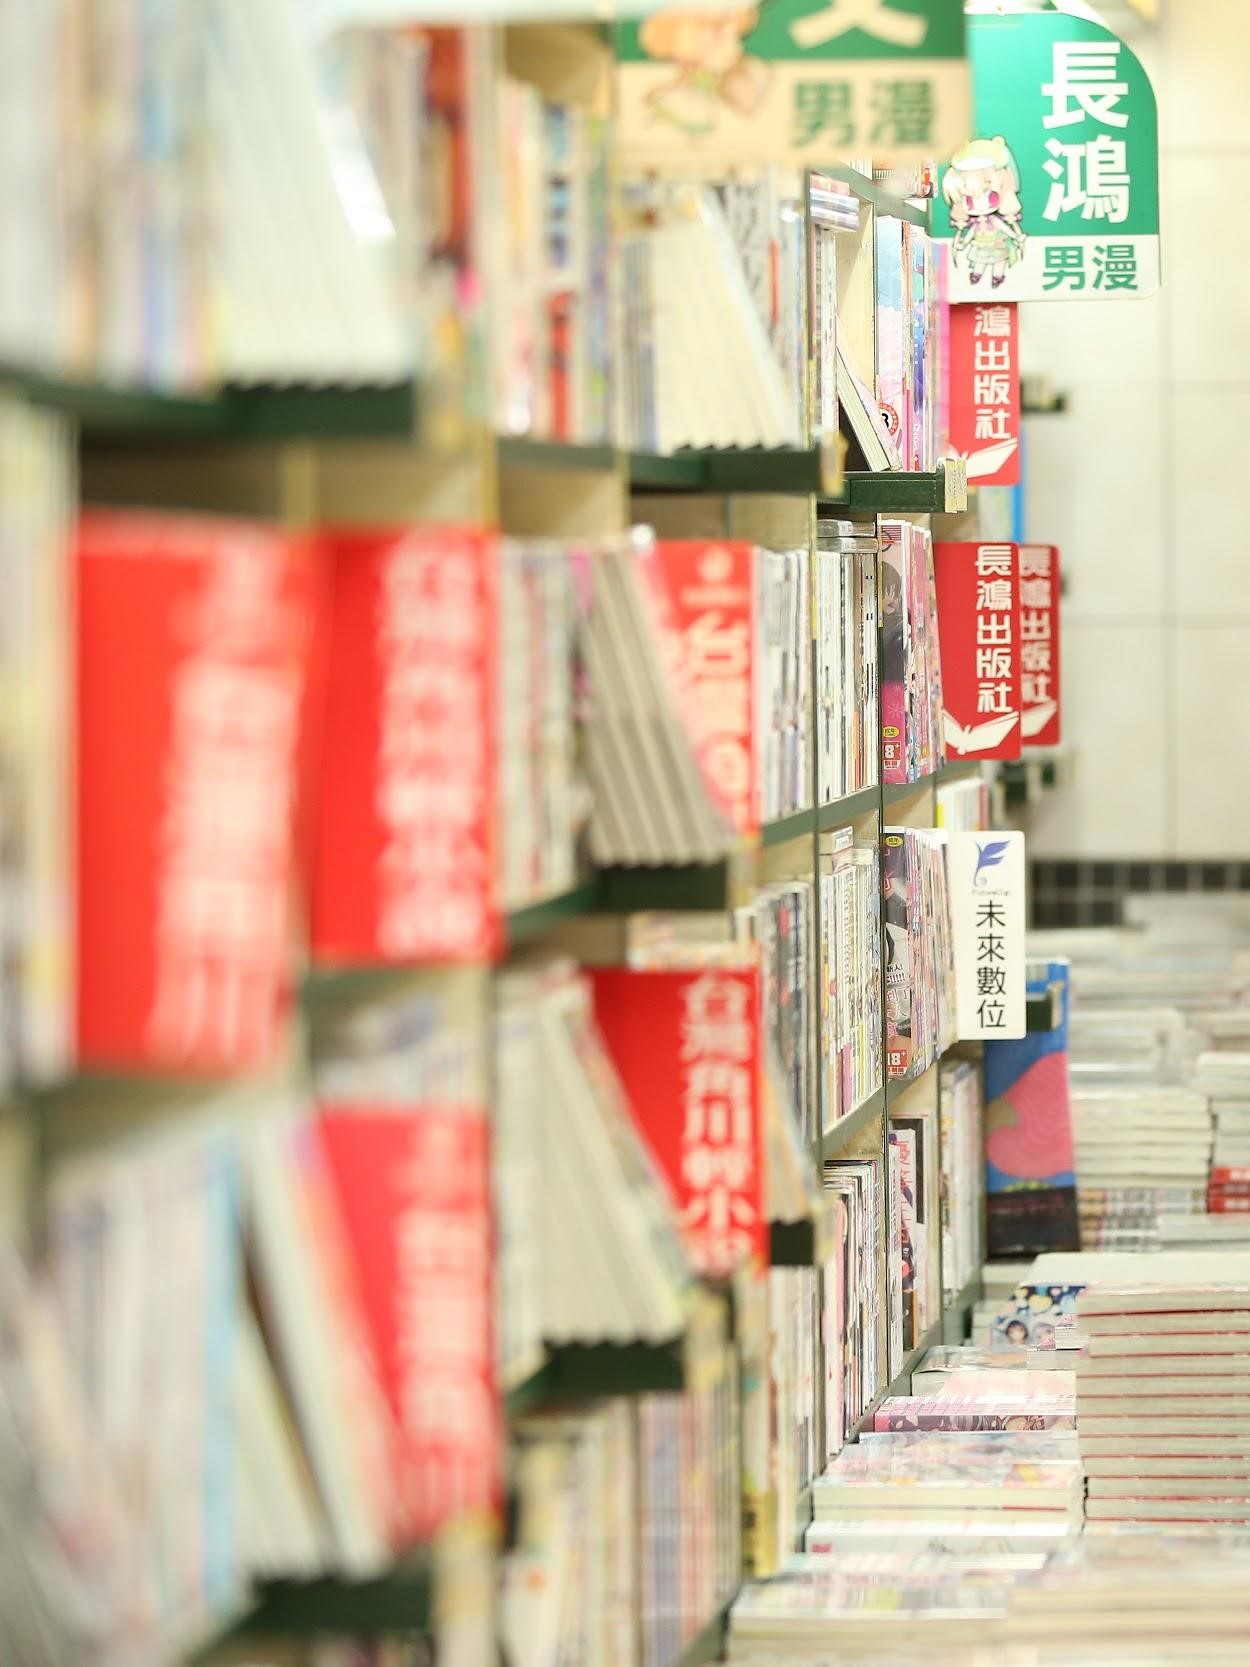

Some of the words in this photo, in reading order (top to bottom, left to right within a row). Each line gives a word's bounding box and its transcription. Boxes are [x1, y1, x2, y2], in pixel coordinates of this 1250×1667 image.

[795, 80, 938, 149] 男漫
[1041, 41, 1131, 224] 長鴻
[1042, 244, 1139, 292] 男漫
[973, 305, 1012, 440] 鴻出版社
[975, 545, 1013, 714] 長鴻出版社
[976, 899, 1007, 1029] 未來數位
